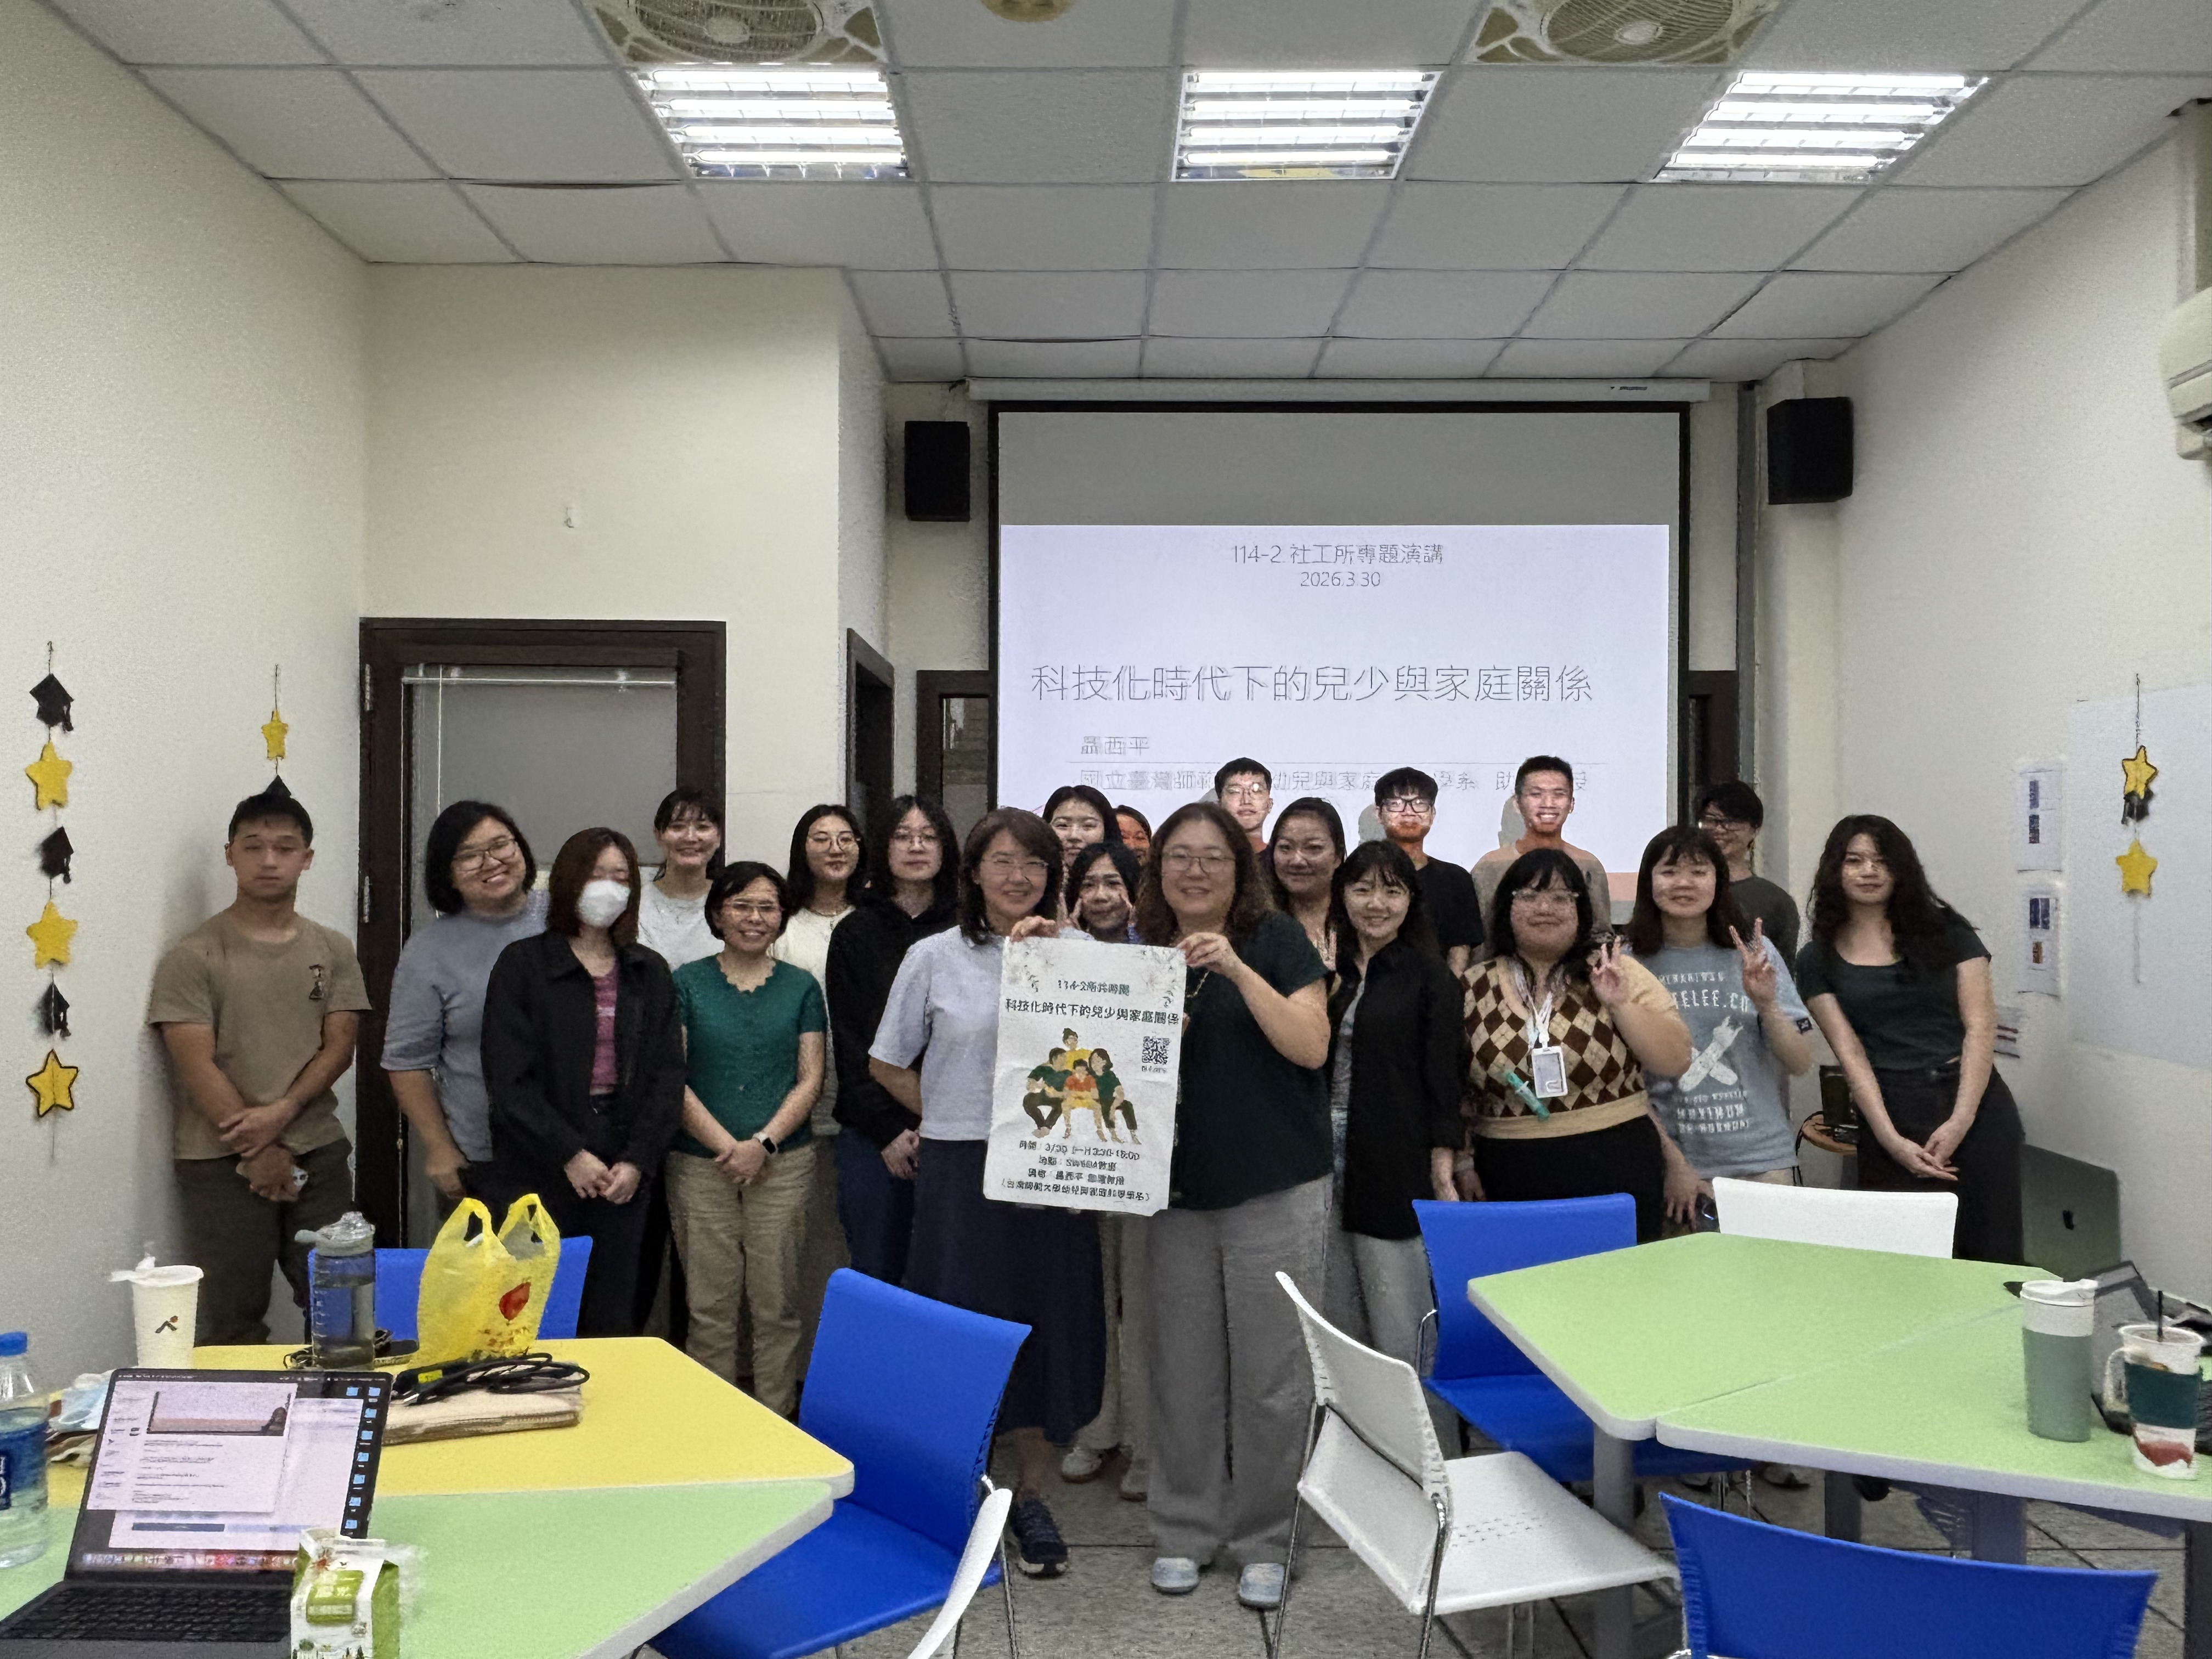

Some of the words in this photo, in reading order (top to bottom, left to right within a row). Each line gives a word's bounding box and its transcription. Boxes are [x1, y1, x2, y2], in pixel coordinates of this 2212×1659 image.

[1234, 545, 1282, 564] 114-2
[1290, 544, 1444, 565] 社工所專題演講
[1031, 664, 1593, 703] 科技化時代下的兒少與家庭關係
